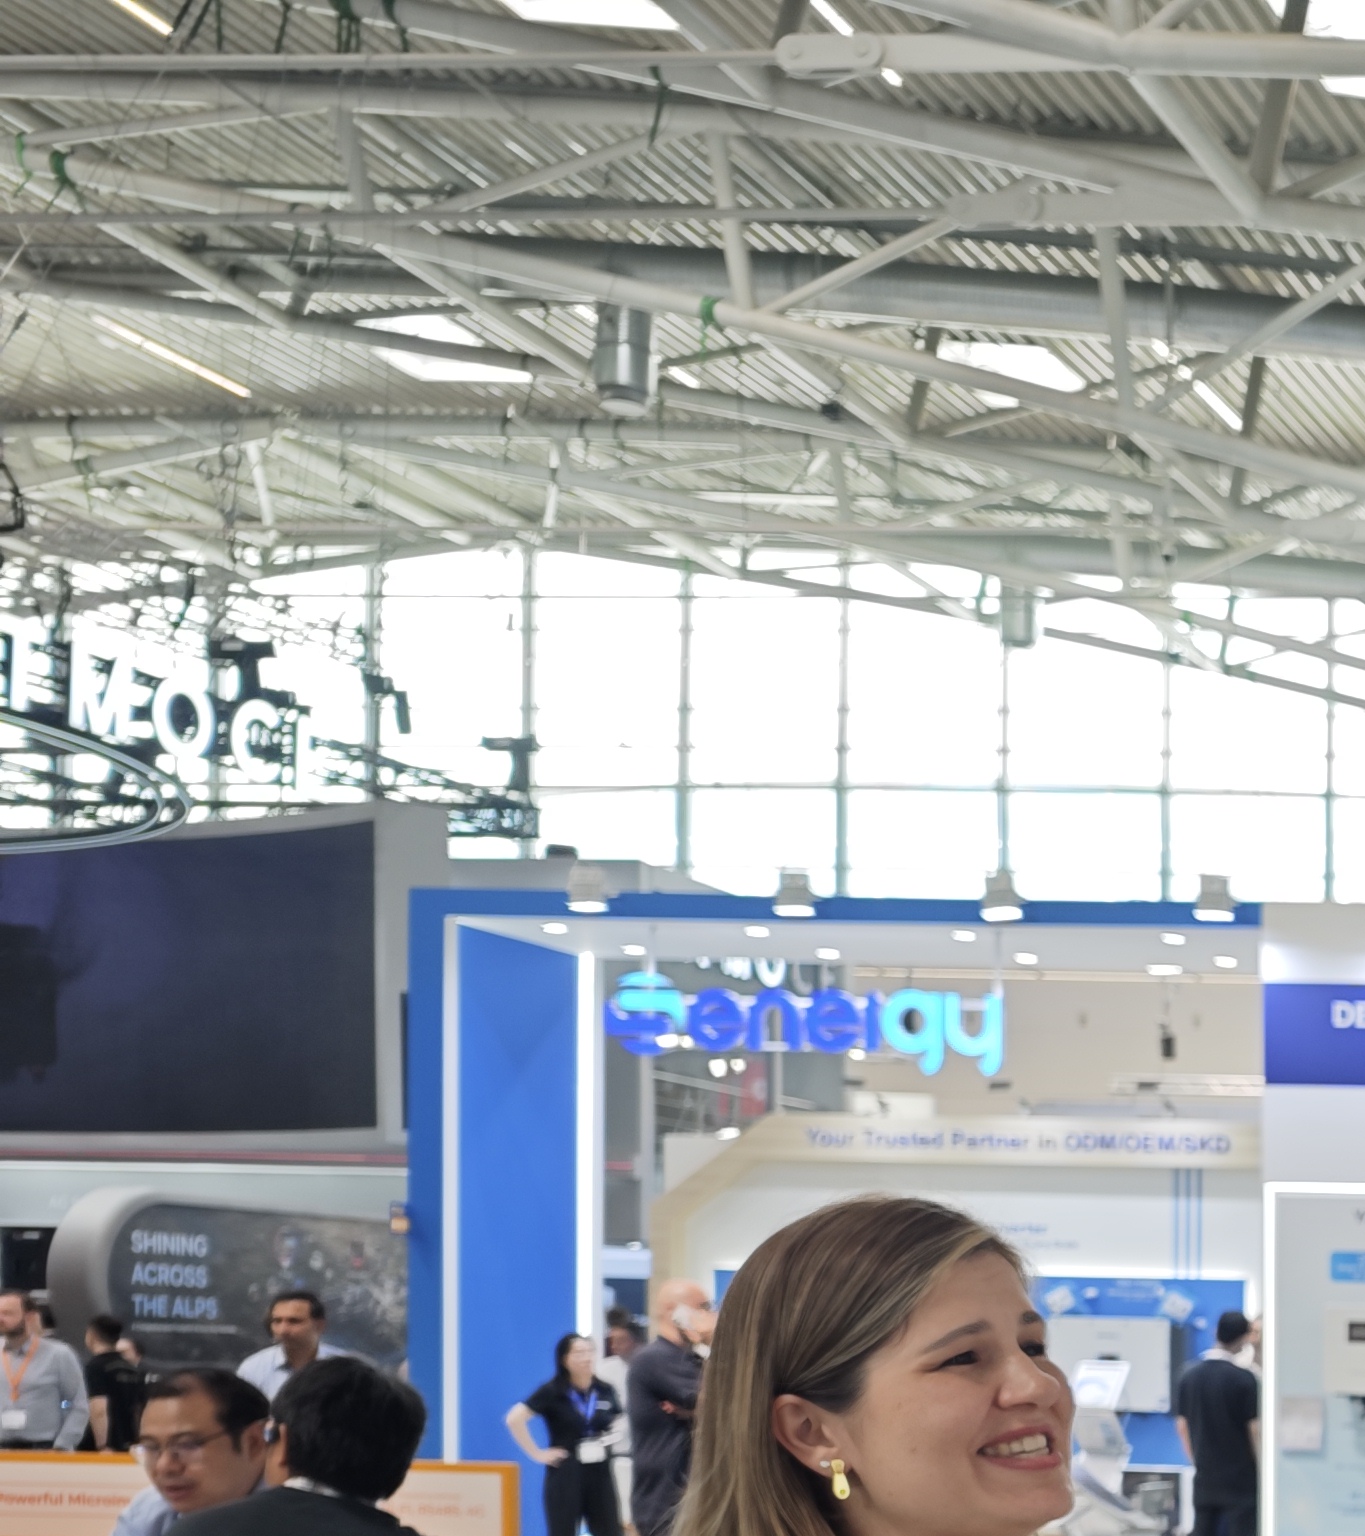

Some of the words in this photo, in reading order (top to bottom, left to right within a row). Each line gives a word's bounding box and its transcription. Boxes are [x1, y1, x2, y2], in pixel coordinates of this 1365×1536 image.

[806, 1127, 854, 1149] Your
[863, 1130, 944, 1150] Trusted
[951, 1131, 1030, 1151] Partner
[131, 1229, 208, 1258] SHINING
[131, 1262, 208, 1289] ACROSS
[131, 1293, 168, 1318] THE
[171, 1295, 218, 1320] ALPS
